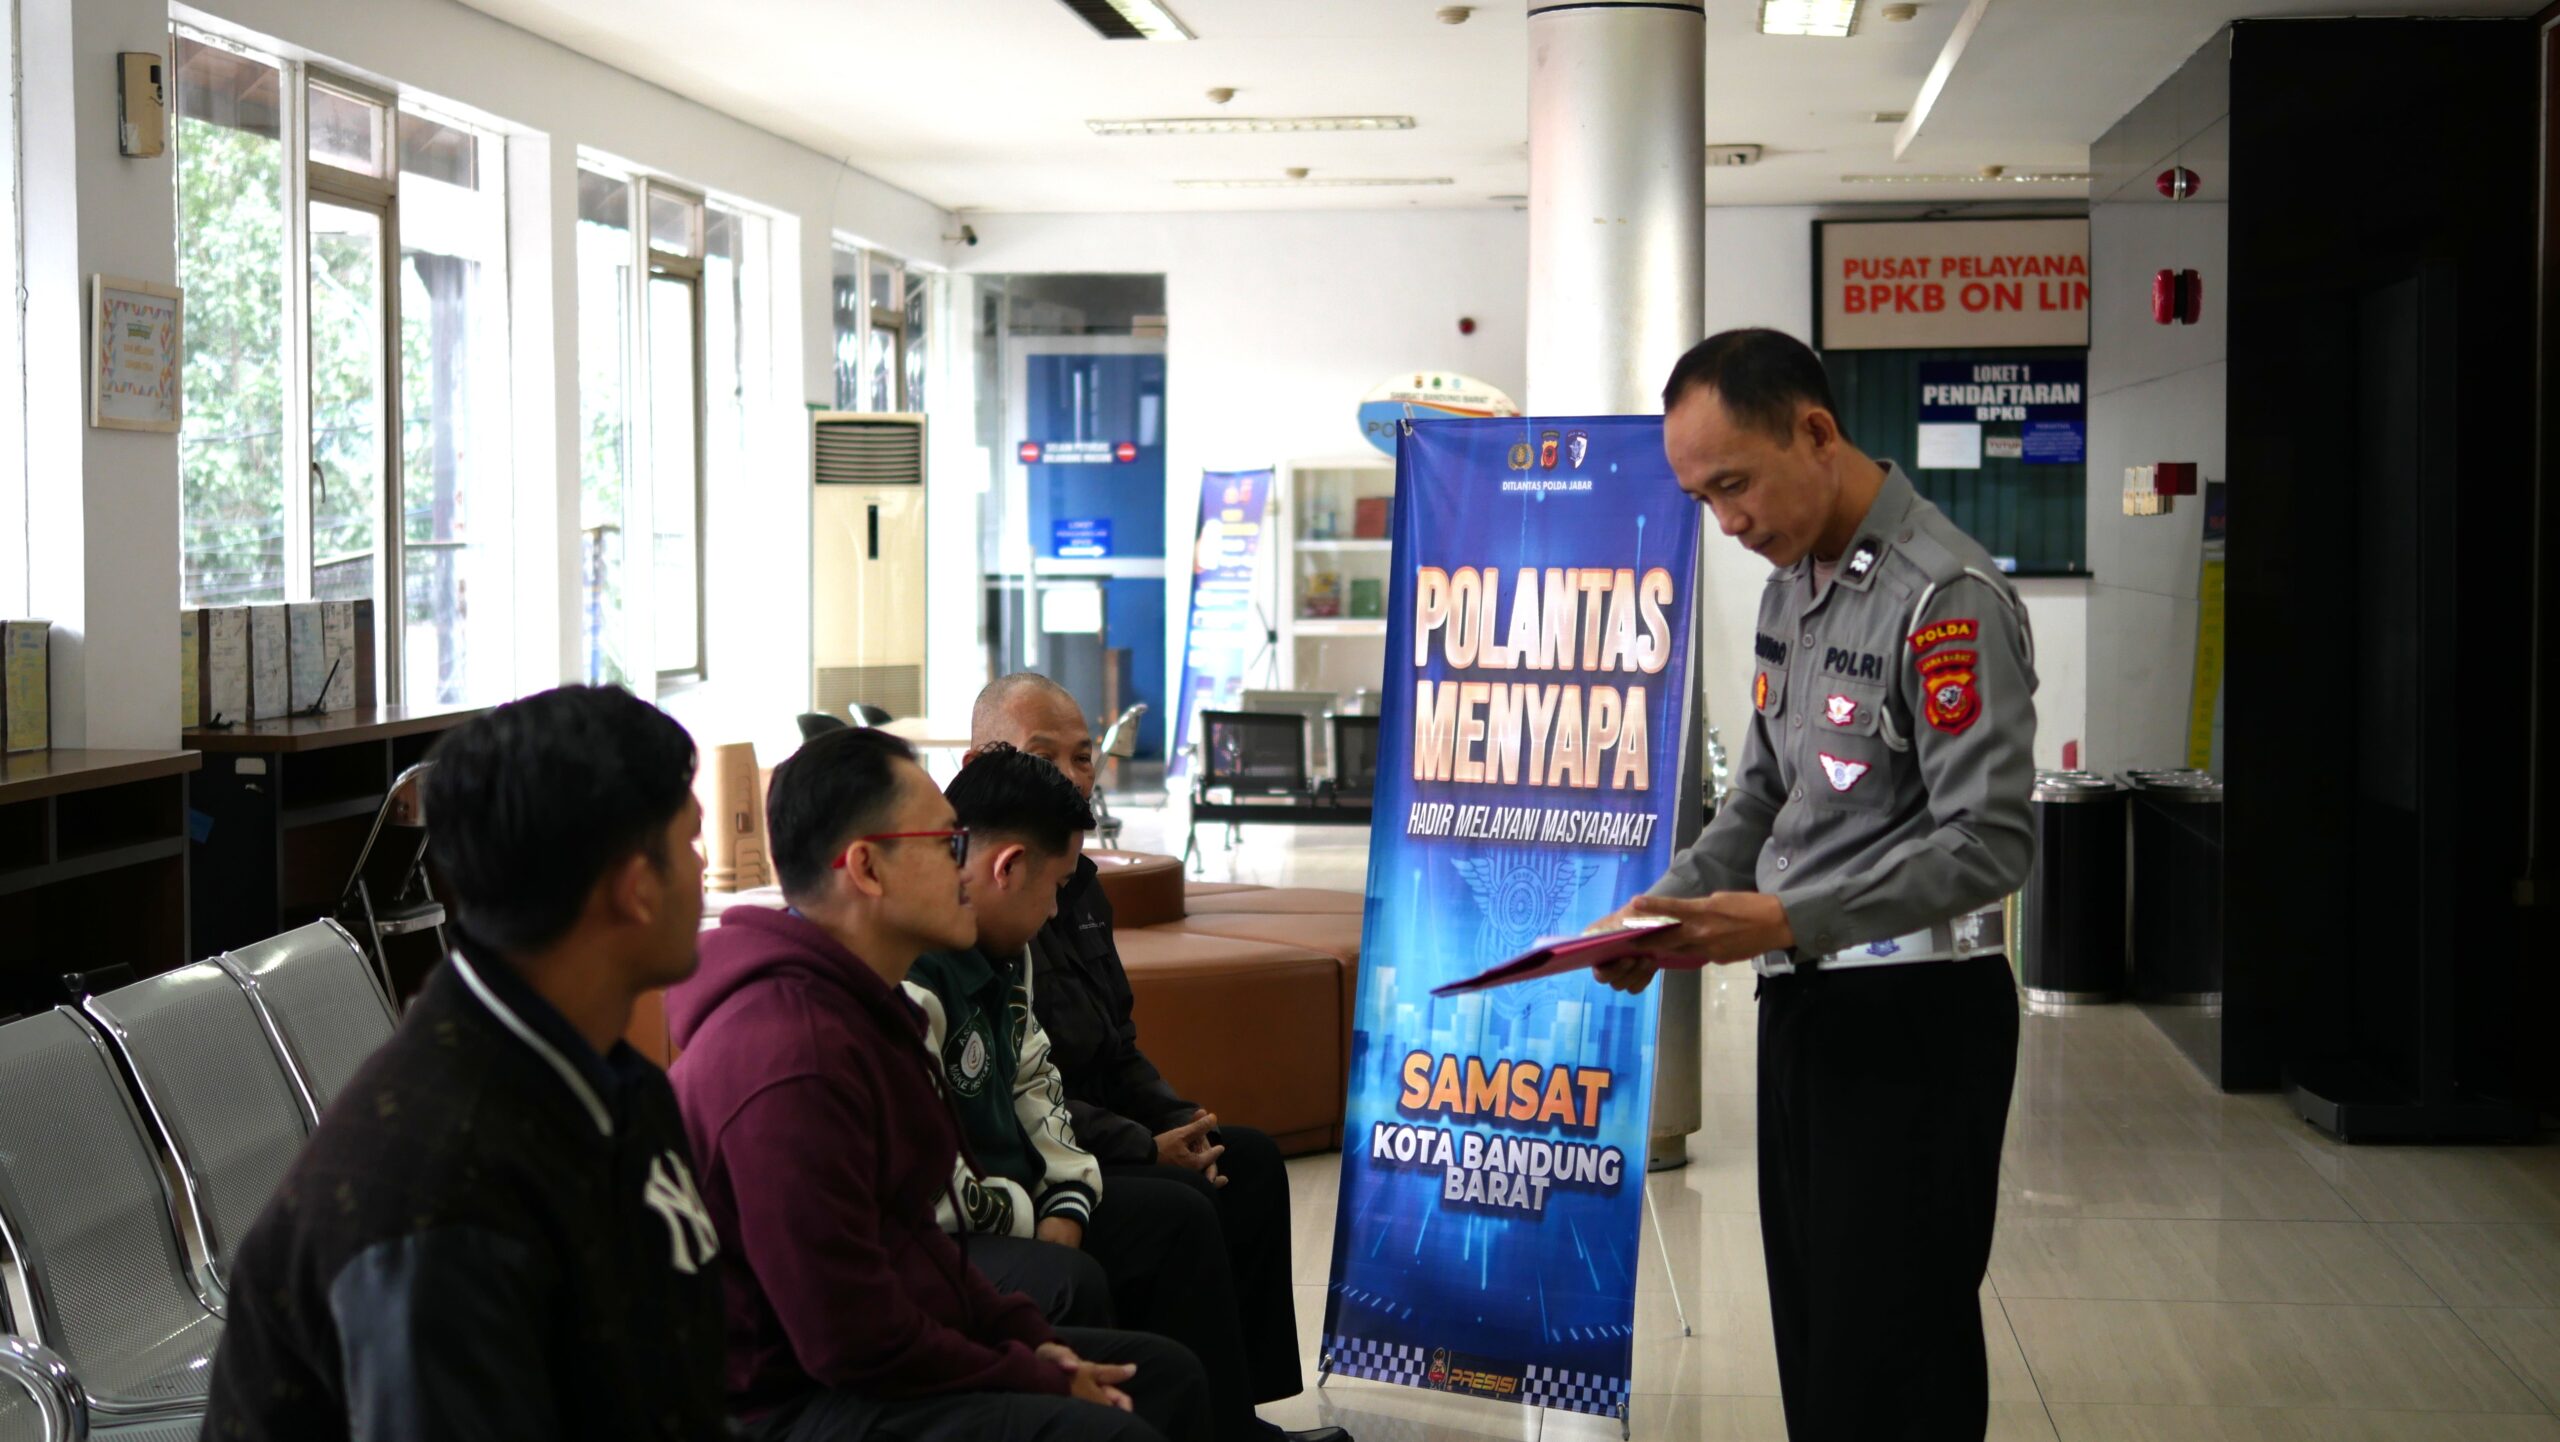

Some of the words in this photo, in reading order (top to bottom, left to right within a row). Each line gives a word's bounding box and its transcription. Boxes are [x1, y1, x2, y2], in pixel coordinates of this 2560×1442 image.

[1843, 257, 1931, 280] PUSAT
[1941, 254, 2089, 279] PELAYANA
[1843, 283, 1947, 314] BPKB
[1959, 282, 2024, 313] ON
[1973, 365, 2018, 382] LOKET
[2022, 365, 2030, 382] 1
[1923, 383, 2080, 406] PENDAFTARAN
[1976, 406, 2027, 421] BPKB
[1502, 481, 1541, 491] DITLANTAS
[1543, 481, 1567, 491] POLDA
[1569, 481, 1592, 490] JABAR
[1415, 566, 1673, 674] POLANTAS
[1915, 624, 1970, 648] POLDA
[1824, 647, 1883, 680] POLRI
[1414, 680, 1649, 790] MENYAPA
[1407, 802, 1452, 836] HADIR
[1453, 805, 1541, 842] MELAYANI
[1540, 809, 1658, 847] MASYARAKAT
[1401, 1052, 1610, 1127] SAMSAT
[1373, 1124, 1455, 1167] KOTA
[1463, 1134, 1622, 1187] BANDUNG
[1444, 1168, 1550, 1211] BARAT
[1448, 1368, 1518, 1394] PRESISI
